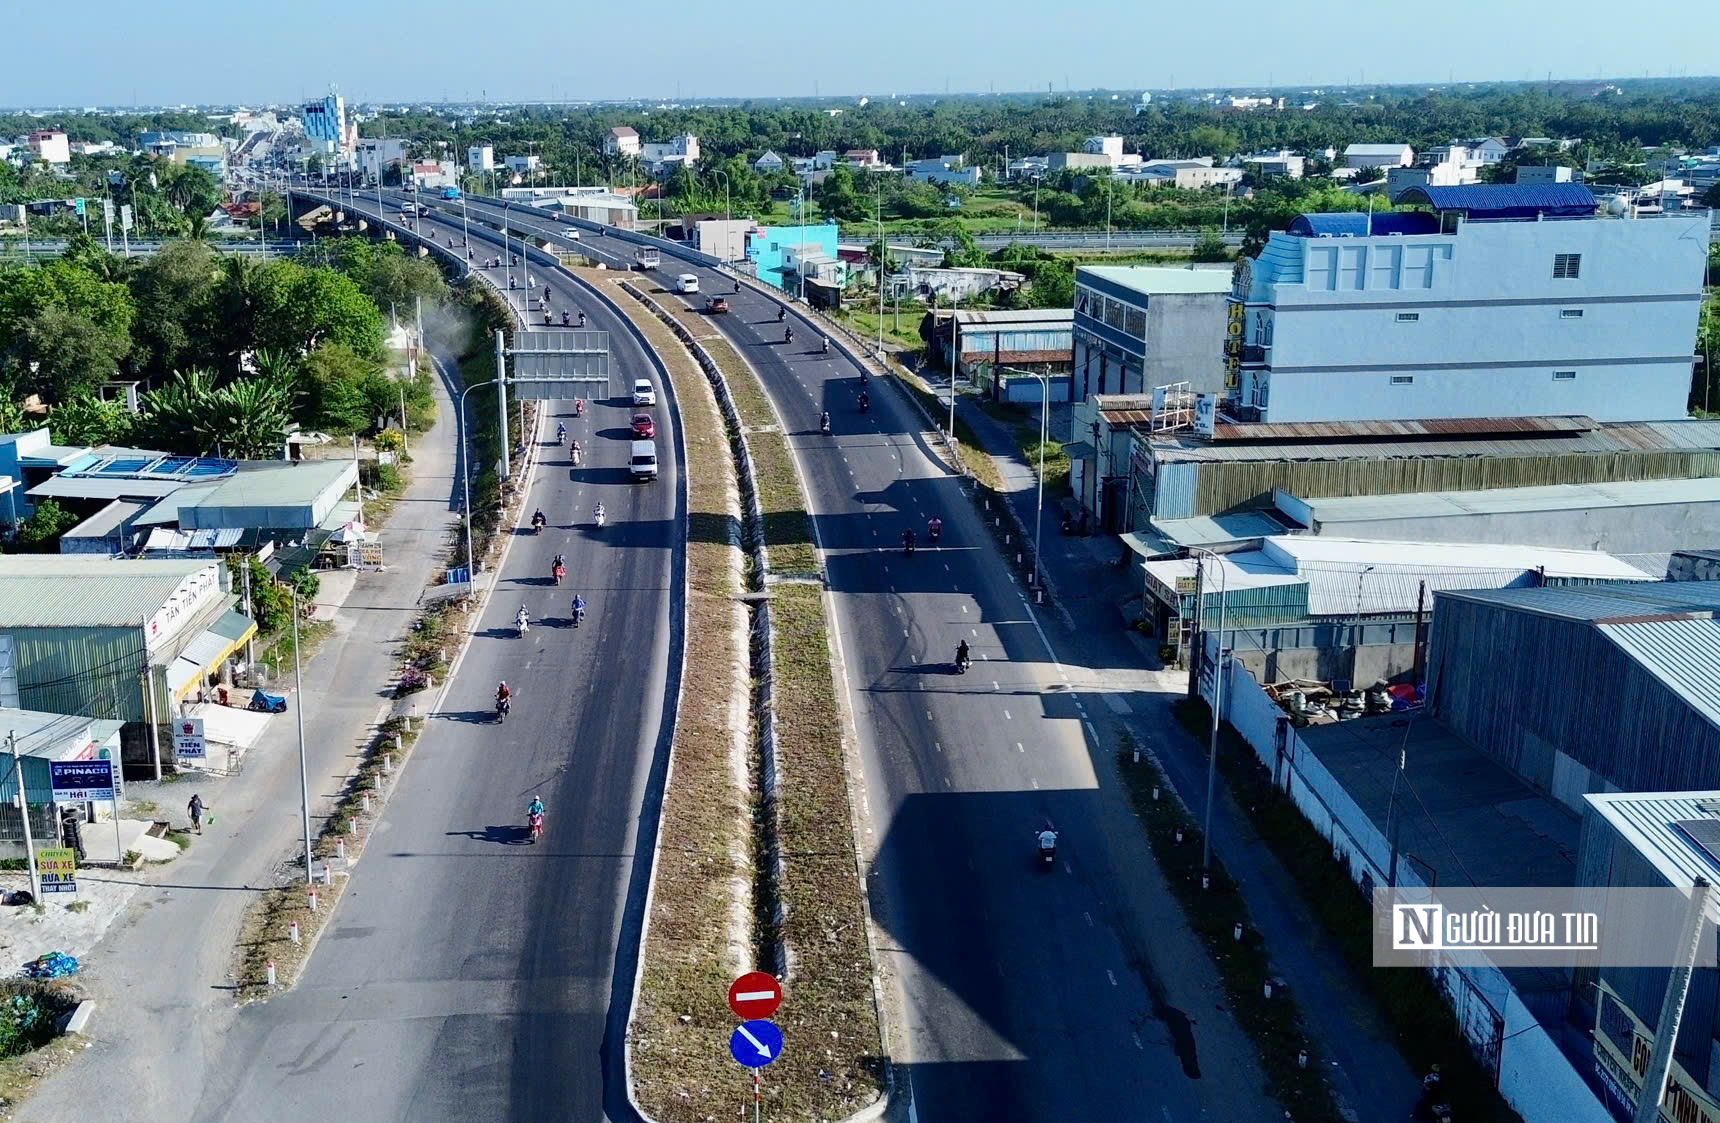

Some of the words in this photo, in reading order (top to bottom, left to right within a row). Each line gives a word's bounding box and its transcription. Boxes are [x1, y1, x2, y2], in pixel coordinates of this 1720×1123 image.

[1226, 304, 1243, 388] HOTEL
[62, 860, 73, 870] XE
[63, 872, 74, 882] XE
